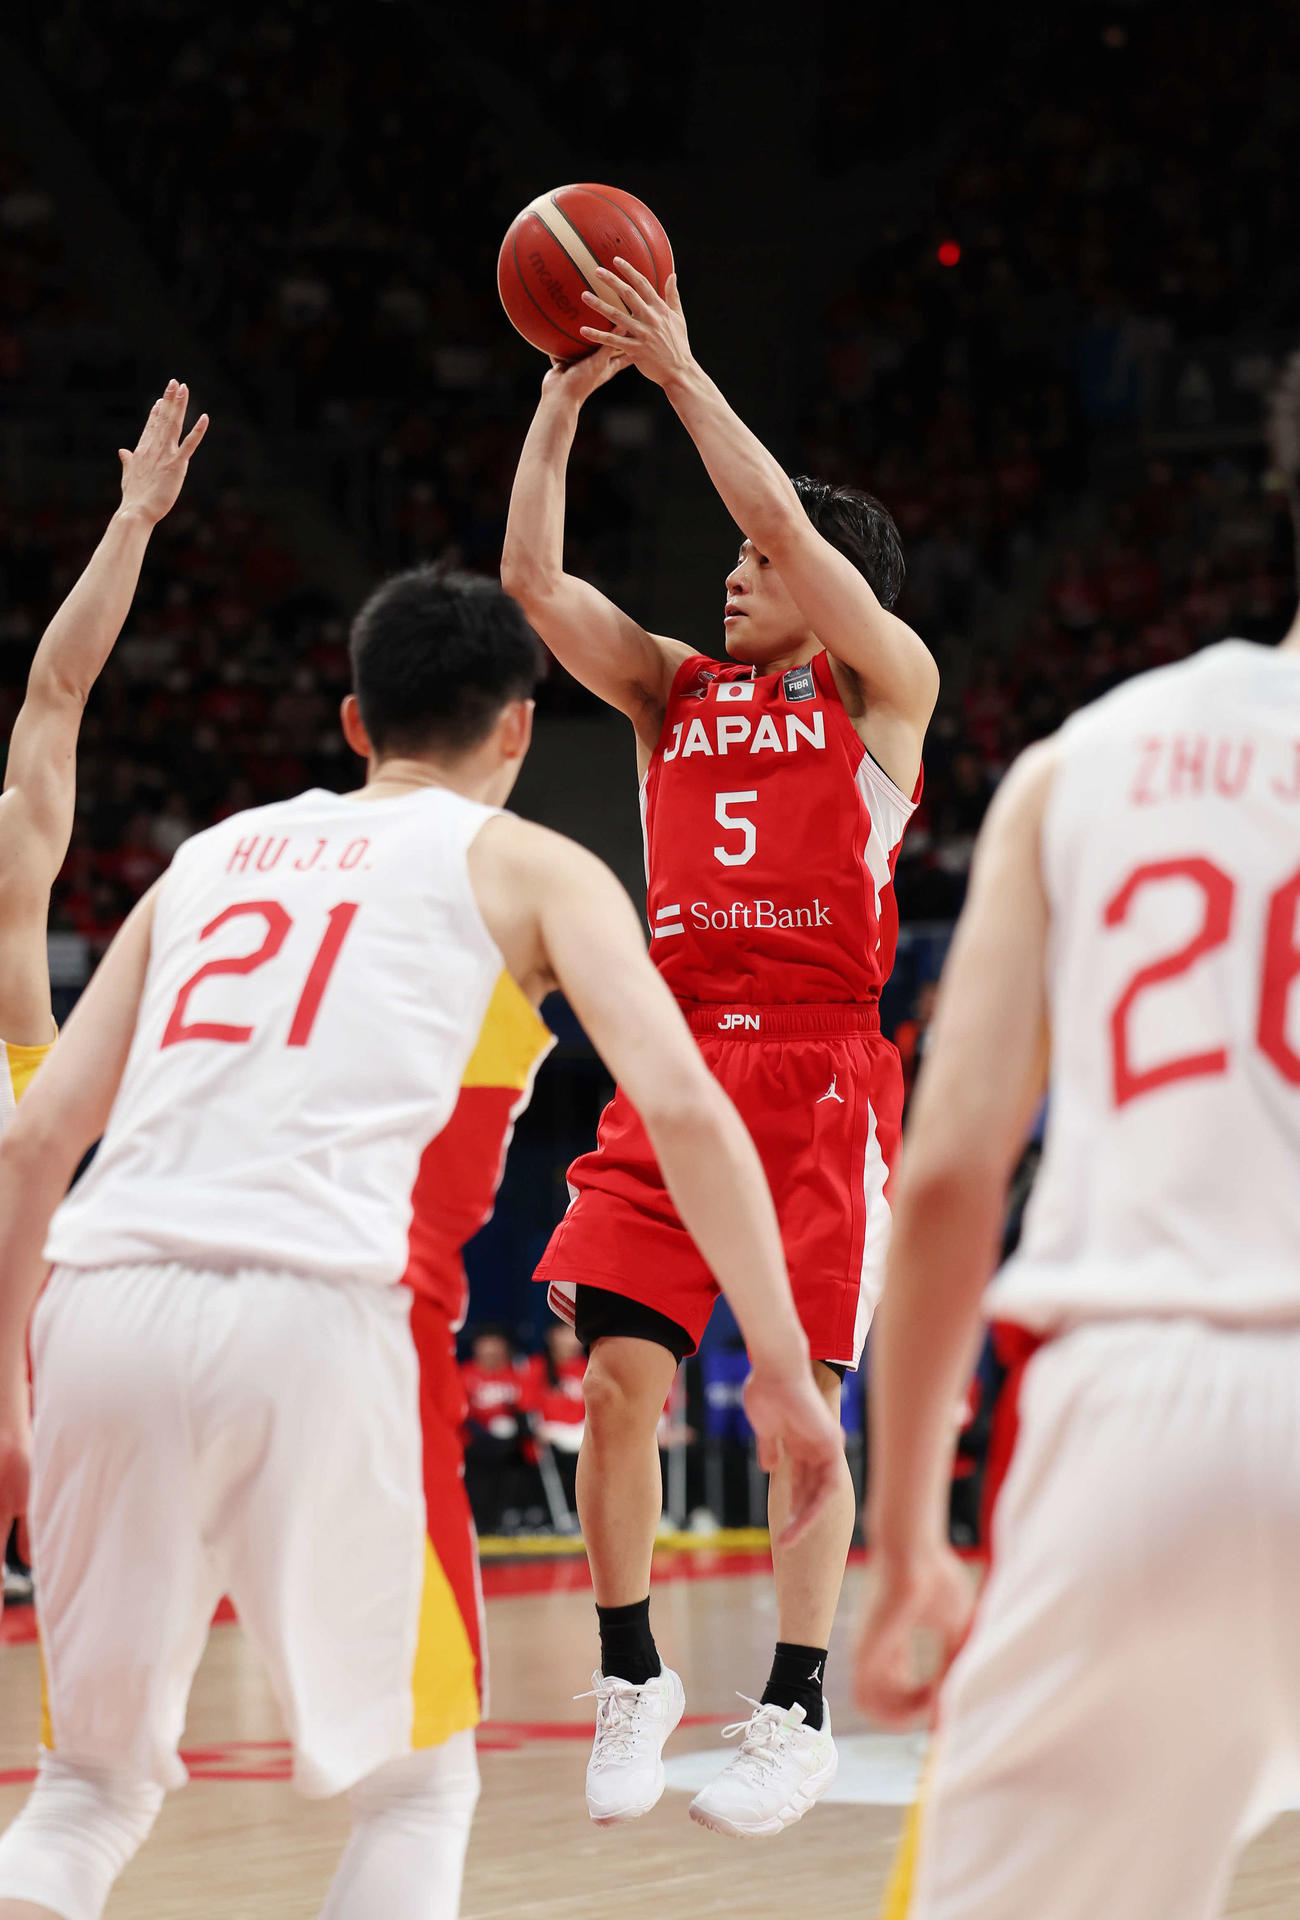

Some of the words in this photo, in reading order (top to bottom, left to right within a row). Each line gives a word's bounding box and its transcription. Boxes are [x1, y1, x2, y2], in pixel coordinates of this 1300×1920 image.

[528, 251, 579, 320] molten
[788, 678, 809, 692] FIBA
[663, 711, 826, 763] JAPAN
[1130, 733, 1254, 807] ZHU
[713, 790, 759, 867] 5
[225, 835, 290, 875] HU
[690, 898, 833, 930] SoftBank
[159, 899, 360, 1050] 21
[717, 1014, 760, 1031] JPN
